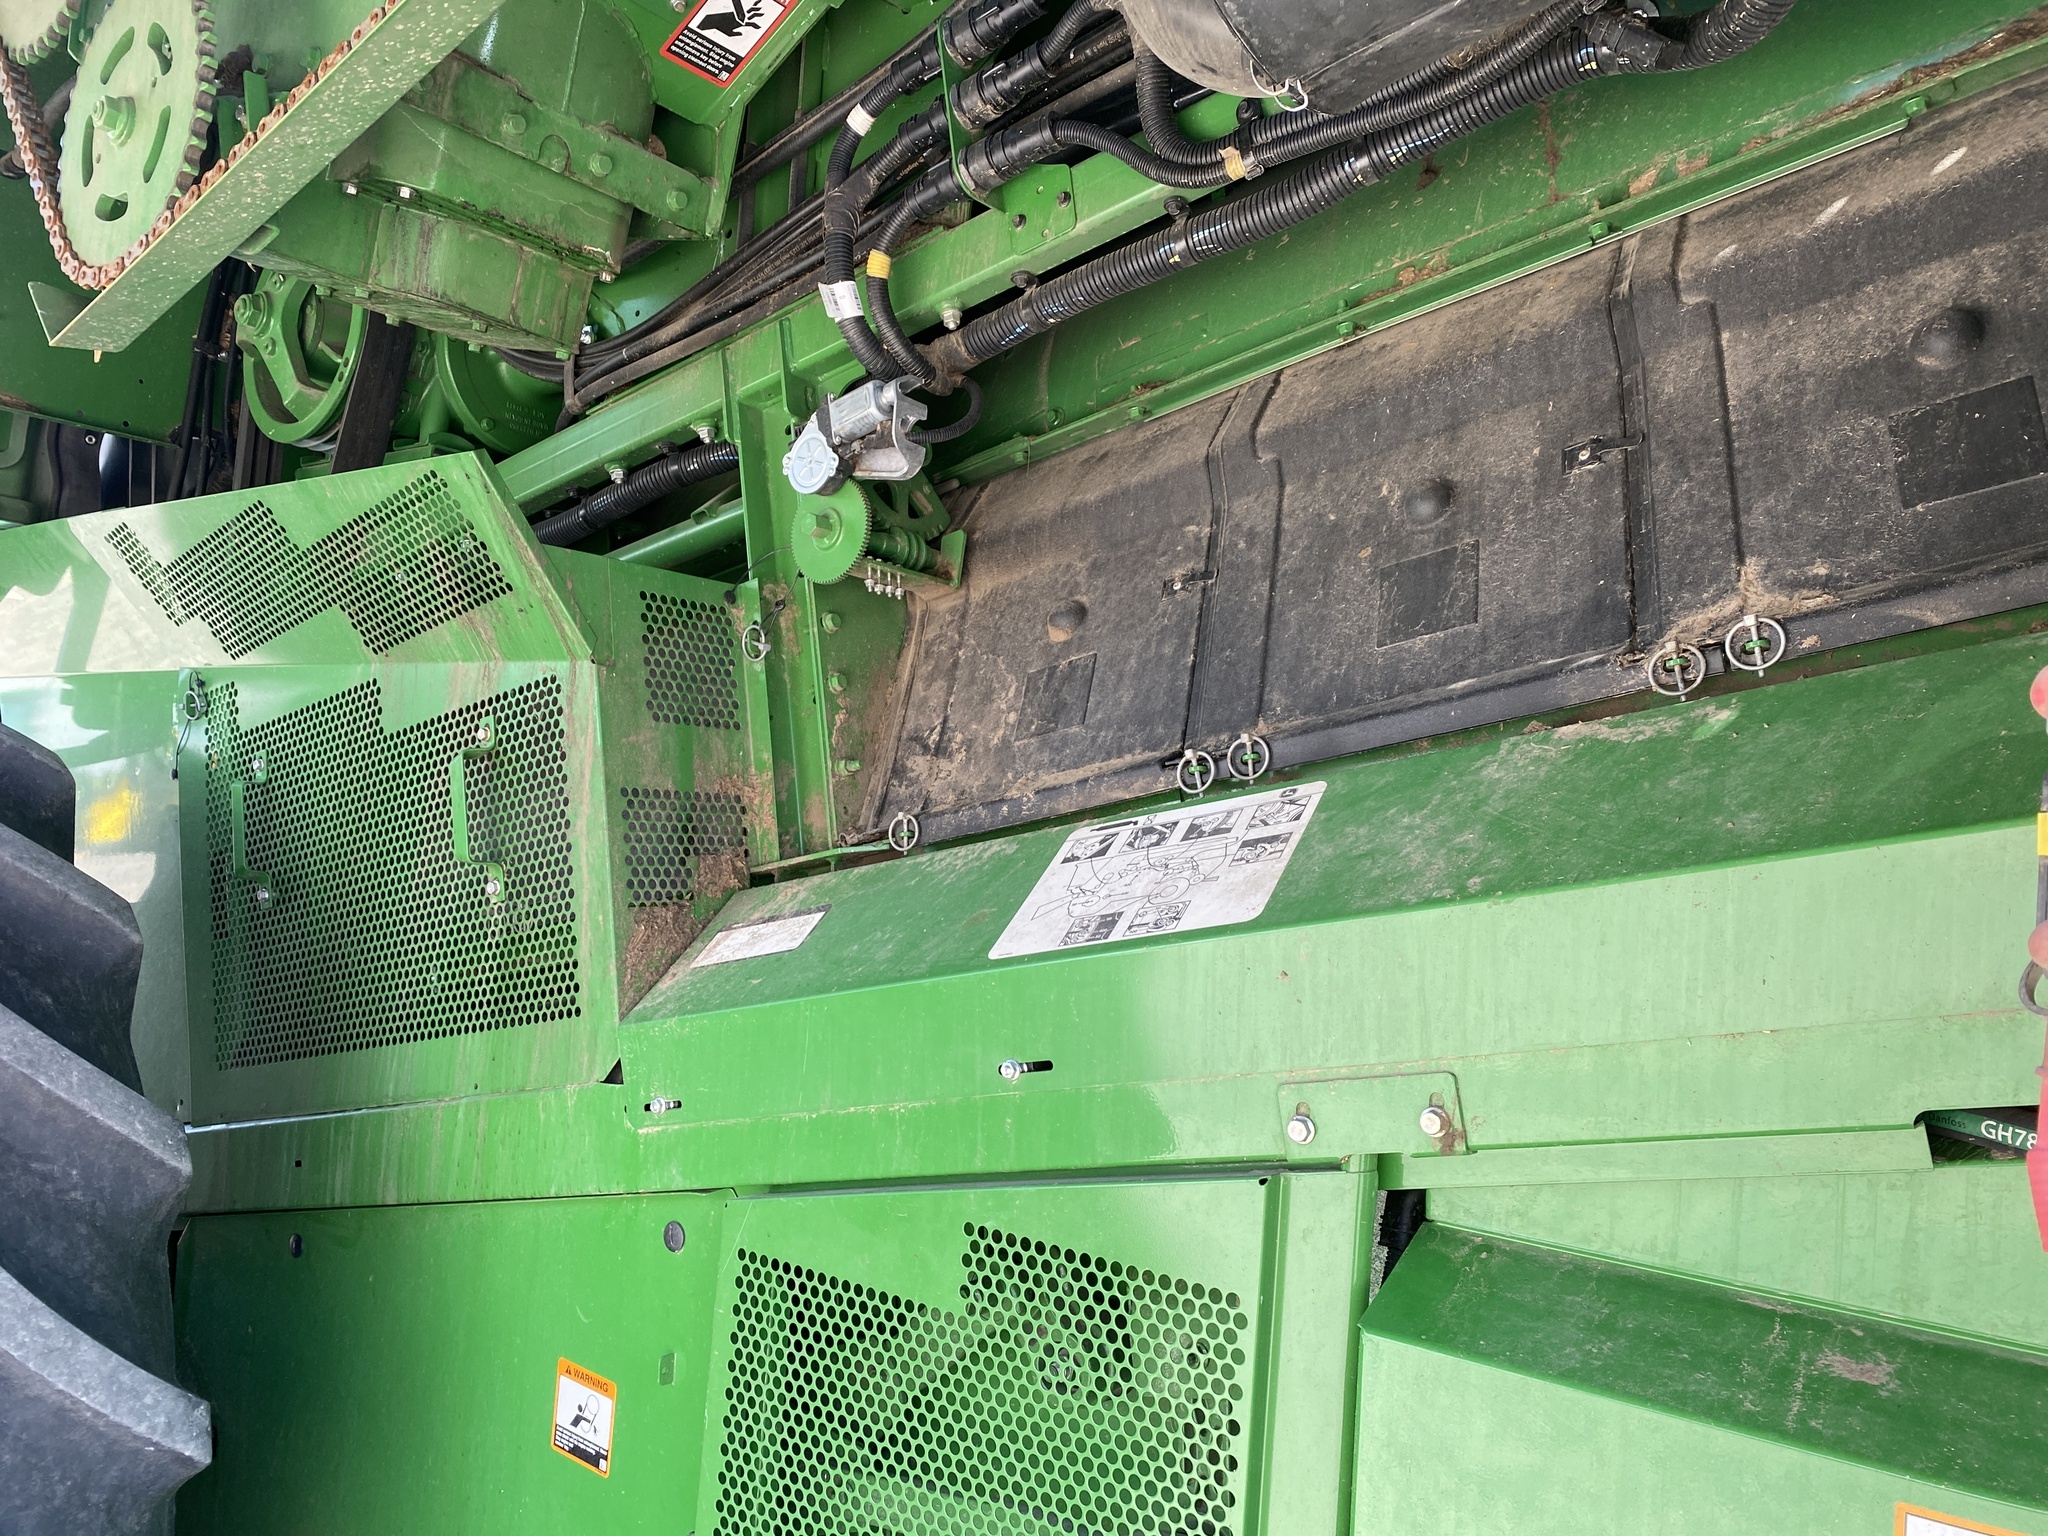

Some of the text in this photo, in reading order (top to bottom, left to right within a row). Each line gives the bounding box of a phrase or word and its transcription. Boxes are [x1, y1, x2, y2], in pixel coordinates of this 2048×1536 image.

[670, 44, 720, 75] opening cleanout doors.
[674, 39, 723, 69] and remove key before
[678, 34, 736, 69] entanglement. Stop engine
[682, 29, 737, 62] Avoid serious injury from
[1927, 1111, 1967, 1129] Danfoss
[573, 1367, 609, 1393] WARNING
